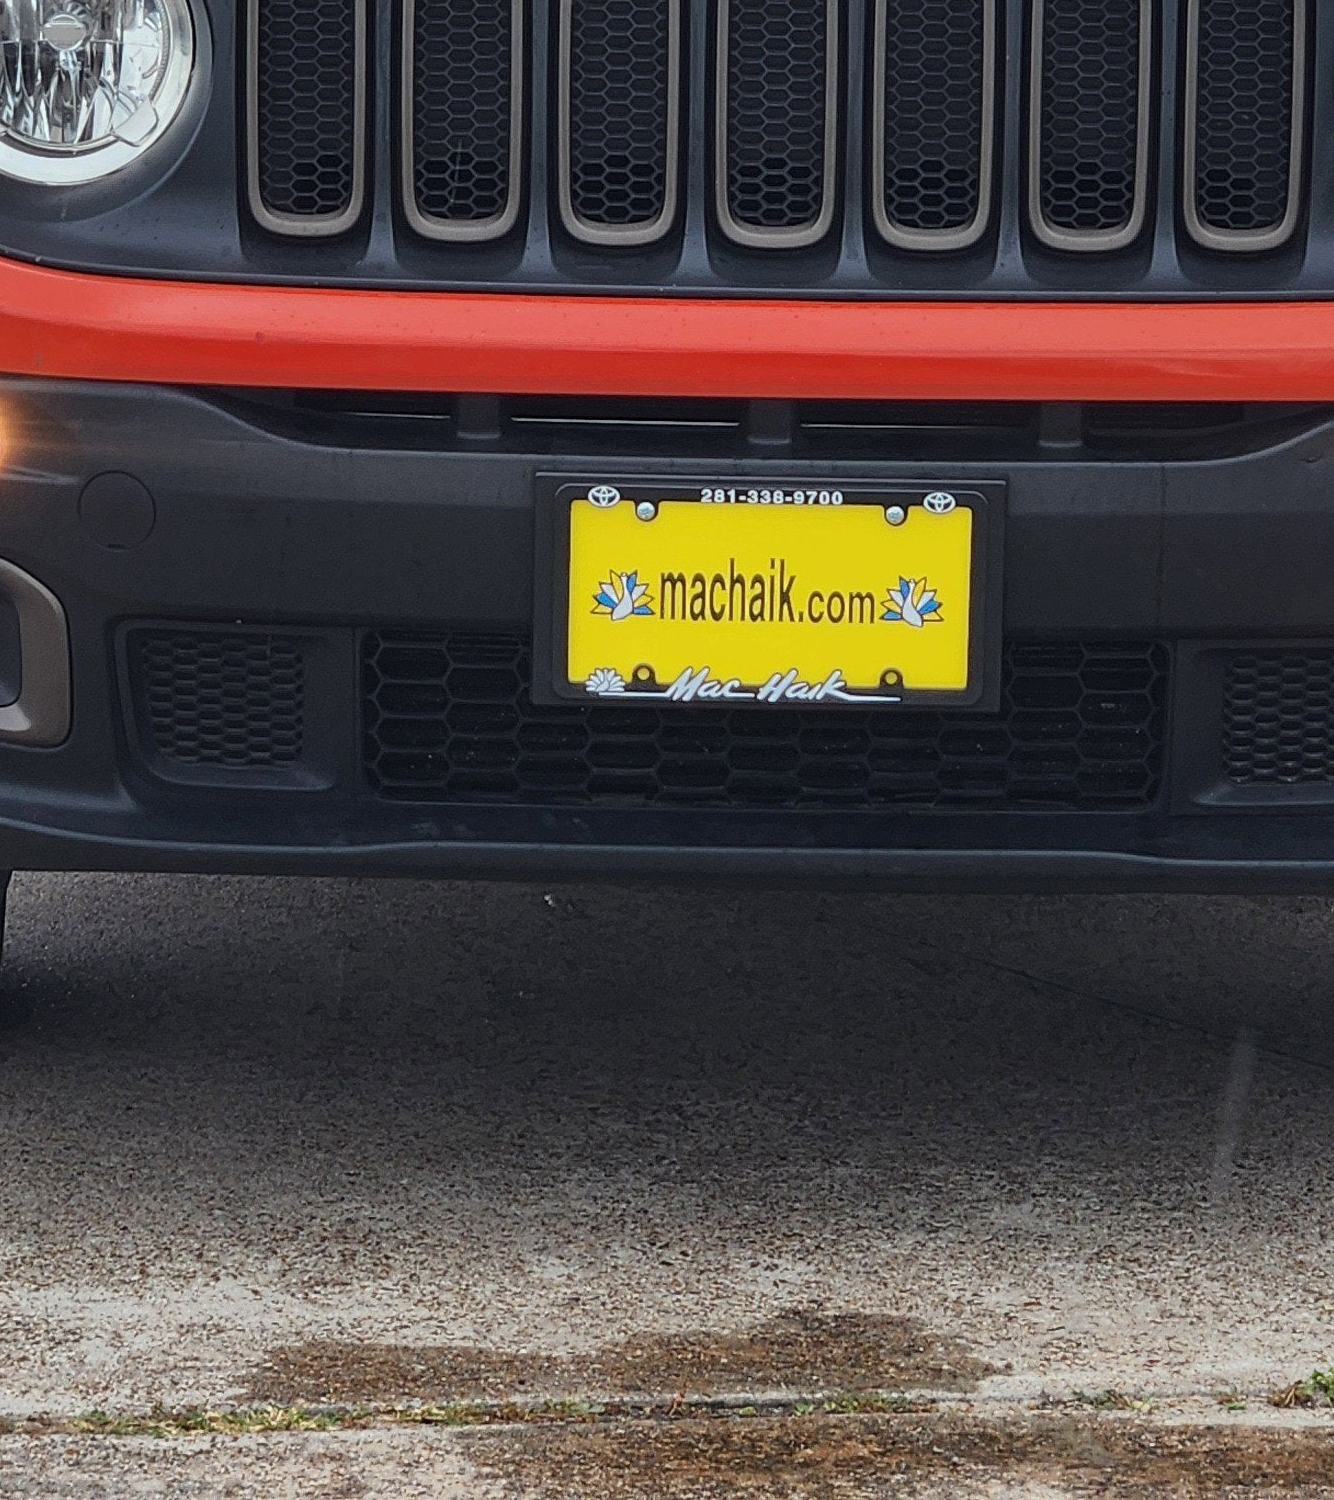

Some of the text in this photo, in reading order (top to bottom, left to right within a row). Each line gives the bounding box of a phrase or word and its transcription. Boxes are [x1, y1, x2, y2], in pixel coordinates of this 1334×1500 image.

[700, 487, 844, 506] 281-338-9700
[658, 557, 876, 625] machaik.com
[665, 665, 755, 702] Mac
